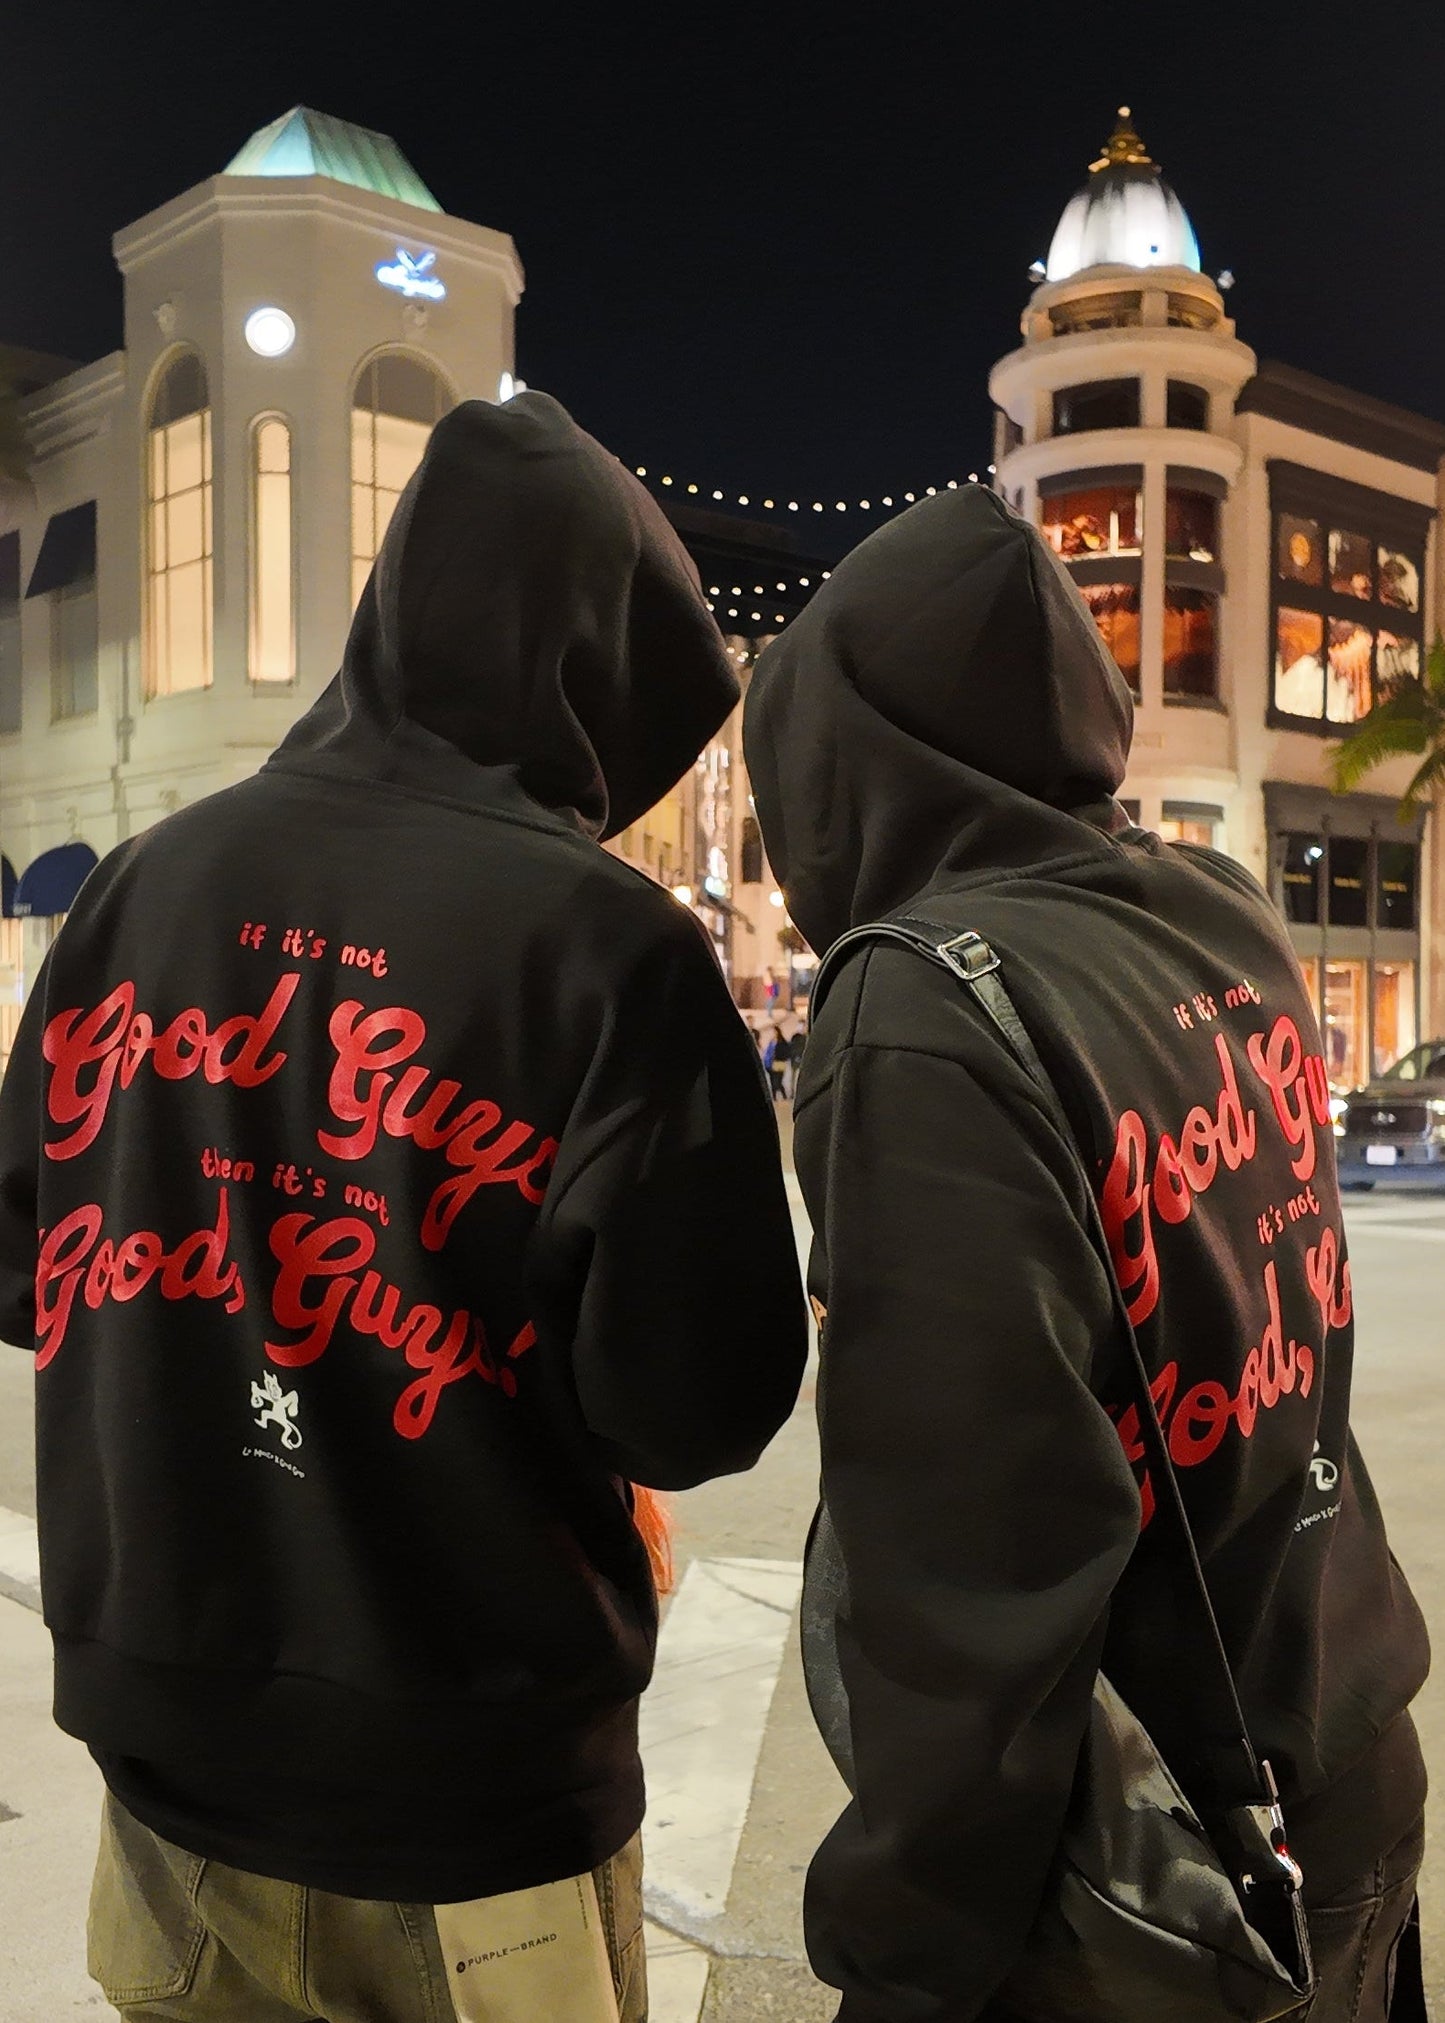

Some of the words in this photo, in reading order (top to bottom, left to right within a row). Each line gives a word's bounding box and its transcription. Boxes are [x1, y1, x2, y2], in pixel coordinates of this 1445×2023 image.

[239, 922, 267, 950] if
[282, 928, 327, 959] it's
[341, 945, 388, 978] not
[1173, 1003, 1194, 1030] if
[1192, 992, 1218, 1021] it's
[1224, 978, 1261, 1009] not
[42, 973, 300, 1161] Good
[272, 1164, 327, 1198] it's
[344, 1184, 390, 1227] not
[1257, 1204, 1284, 1245] it's
[1287, 1185, 1320, 1222] not
